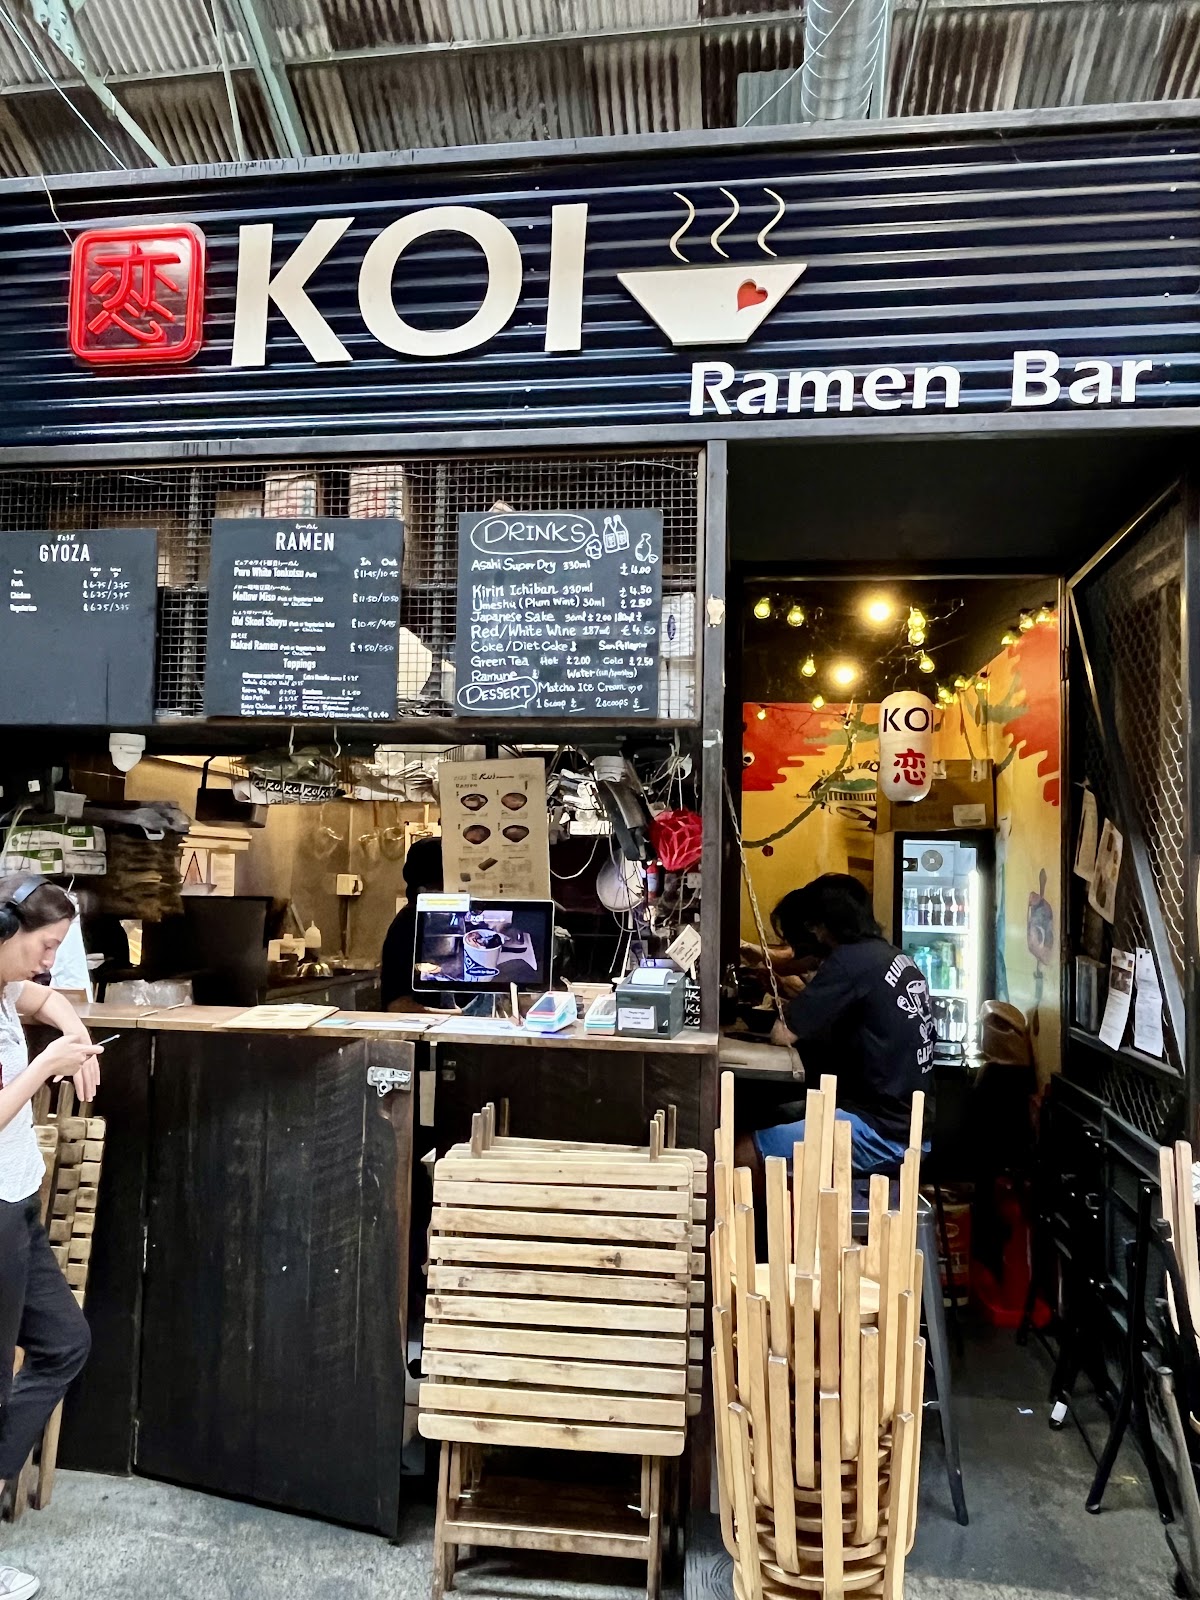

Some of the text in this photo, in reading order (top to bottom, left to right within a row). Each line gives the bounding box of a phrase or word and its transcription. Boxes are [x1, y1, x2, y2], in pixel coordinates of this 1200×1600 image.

[88, 242, 182, 343] 恋
[230, 202, 589, 368] KOI
[688, 349, 1153, 416] Ramen Bar
[484, 520, 586, 544] DRINKS
[275, 532, 335, 551] RAMEN
[39, 543, 90, 562] GYOZA
[470, 559, 501, 572] Asahi
[502, 558, 536, 573] Super
[536, 559, 557, 574] Dry
[562, 559, 591, 570] 330ml
[472, 584, 505, 598] Kirin
[510, 583, 559, 596] Ichiban
[562, 583, 594, 595] 330ml
[472, 598, 517, 611] Umeshu
[519, 597, 551, 610] (Plum
[552, 595, 580, 608] Wine)
[582, 596, 605, 608] 30ml
[231, 616, 244, 626] Old
[470, 612, 522, 624] Japanese
[523, 612, 556, 623] Sake
[470, 624, 543, 639] Red/White
[546, 624, 577, 637] Wine
[470, 641, 541, 653] Coke/Diet
[541, 641, 568, 652] Coke
[282, 657, 317, 671] Toppings
[470, 656, 507, 668] Green
[508, 656, 530, 667] Tea
[540, 656, 559, 666] Hot
[602, 656, 624, 665] Cold
[471, 669, 518, 682] Ramune
[566, 668, 596, 678] Water
[465, 685, 532, 705] DESSERT
[537, 682, 627, 693] Matcha Ice Cream
[892, 747, 927, 786] 恋
